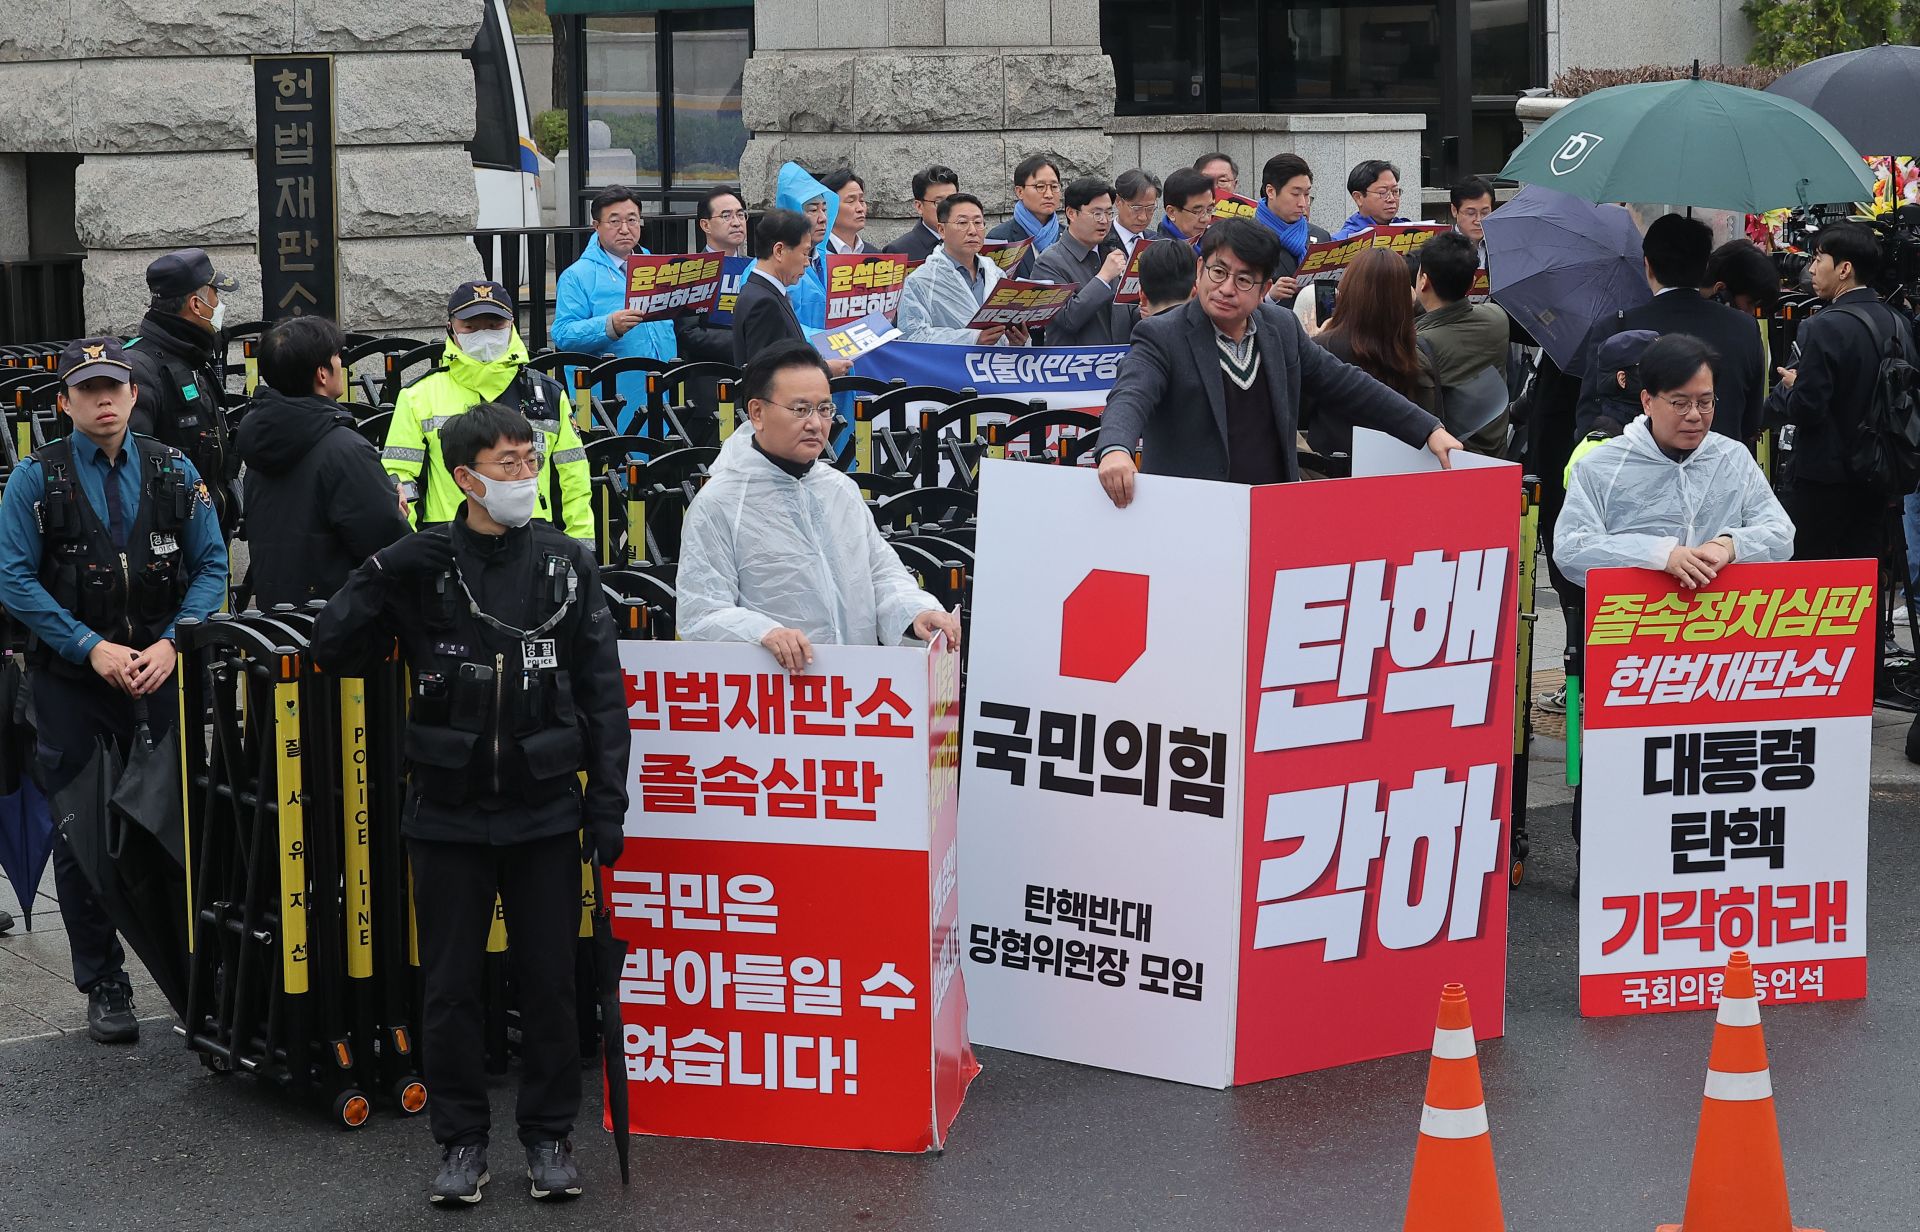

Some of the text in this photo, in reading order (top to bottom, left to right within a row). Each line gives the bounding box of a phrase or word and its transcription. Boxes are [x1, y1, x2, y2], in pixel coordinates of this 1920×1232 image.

[272, 68, 319, 315] 헌법재판소
[628, 281, 719, 314] 파면하라!
[630, 258, 720, 292] 윤석열을
[831, 259, 905, 293] 윤석열을
[987, 288, 1073, 307] 윤석열을
[971, 306, 1062, 324] 파면하라!
[964, 351, 1125, 384] 더불어민주당
[526, 643, 552, 657] 경찰
[1253, 546, 1509, 754] 탄핵
[1587, 585, 1873, 646] 졸속정치심판
[621, 668, 914, 738] 헌법재판소
[1603, 647, 1856, 707] 헌법재판소!
[639, 753, 883, 822] 졸속심판
[972, 701, 1227, 818] 국민의힘
[1643, 727, 1816, 796] 대통령
[353, 727, 369, 946] POLICE LINE
[1253, 762, 1503, 963] 각하
[1670, 806, 1786, 875] 탄핵
[611, 870, 779, 934] 국민은
[1024, 884, 1153, 943] 탄핵반대
[619, 948, 843, 1017] 받아들일
[860, 962, 916, 1020] 수
[969, 923, 1129, 988] 당협위원장
[1139, 953, 1205, 1002] 모임
[623, 1023, 858, 1096] 없습니다!
